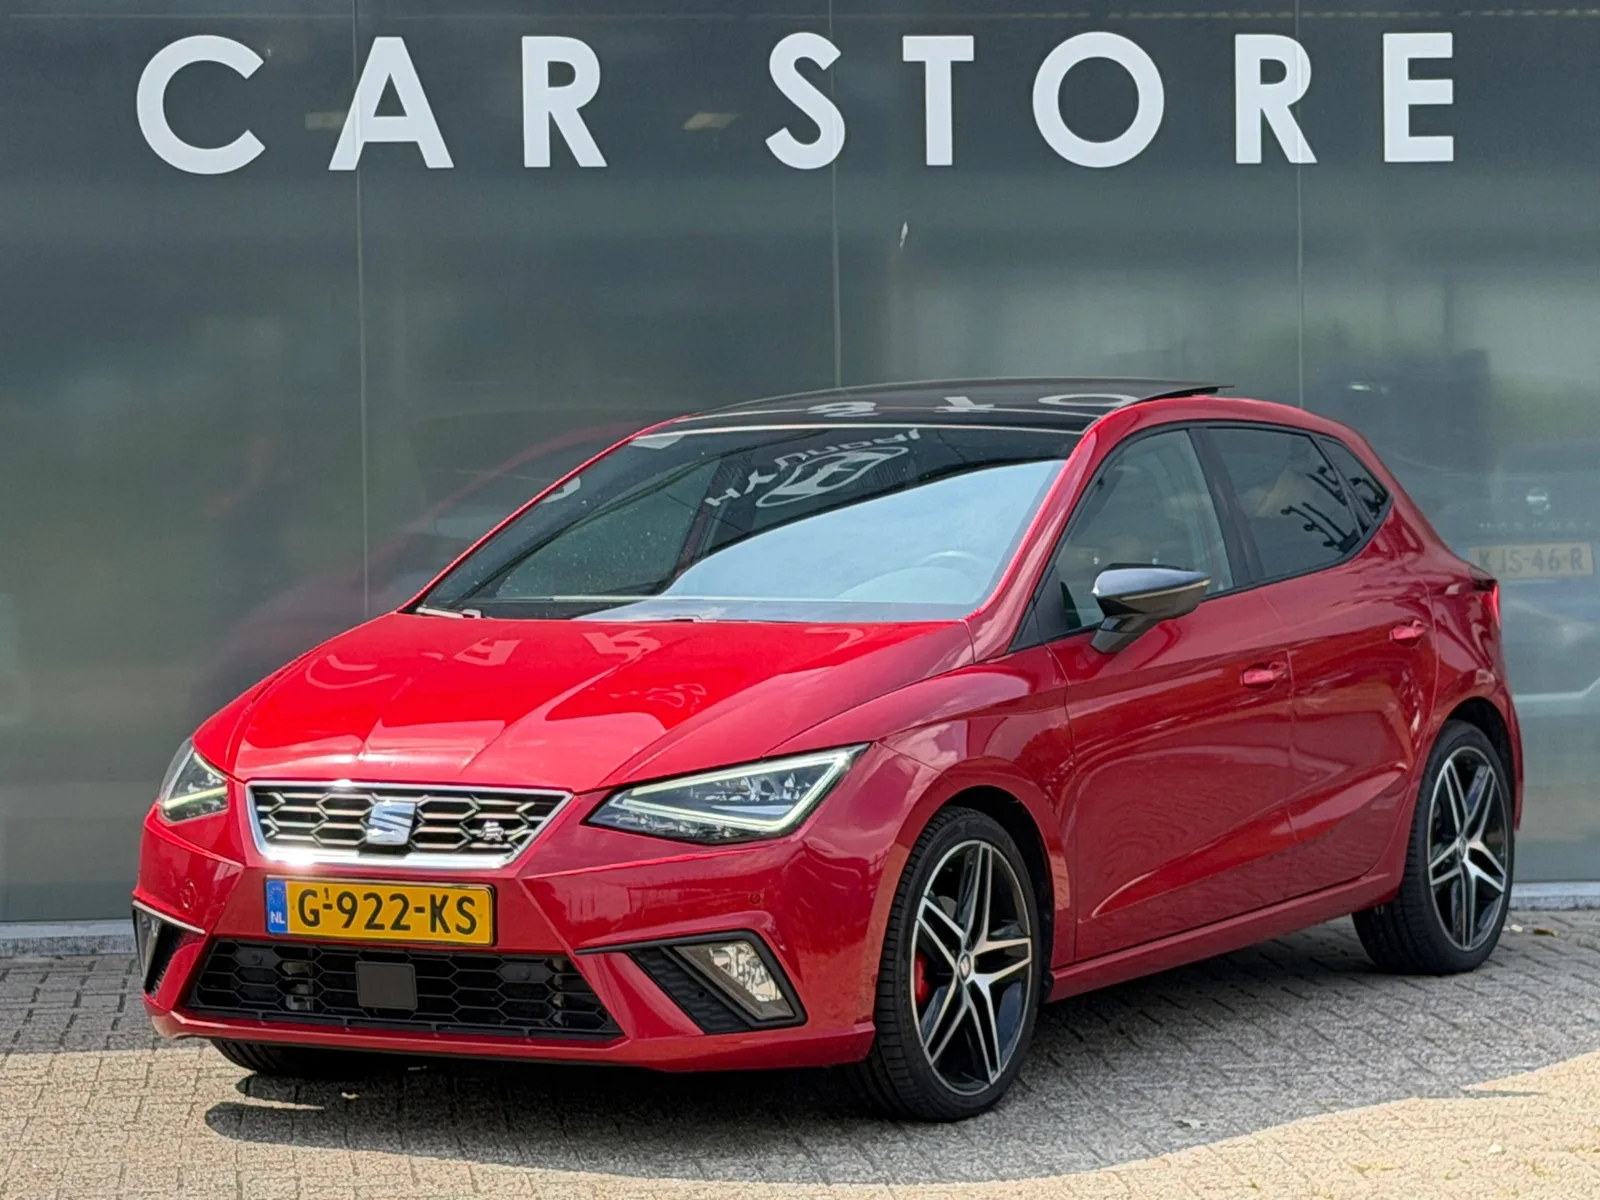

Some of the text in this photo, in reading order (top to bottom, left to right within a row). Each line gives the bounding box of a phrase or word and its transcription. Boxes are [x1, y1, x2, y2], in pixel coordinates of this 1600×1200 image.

[136, 31, 1454, 175] CAR STORE
[270, 912, 286, 925] NL
[297, 888, 478, 935] G-922-KS
